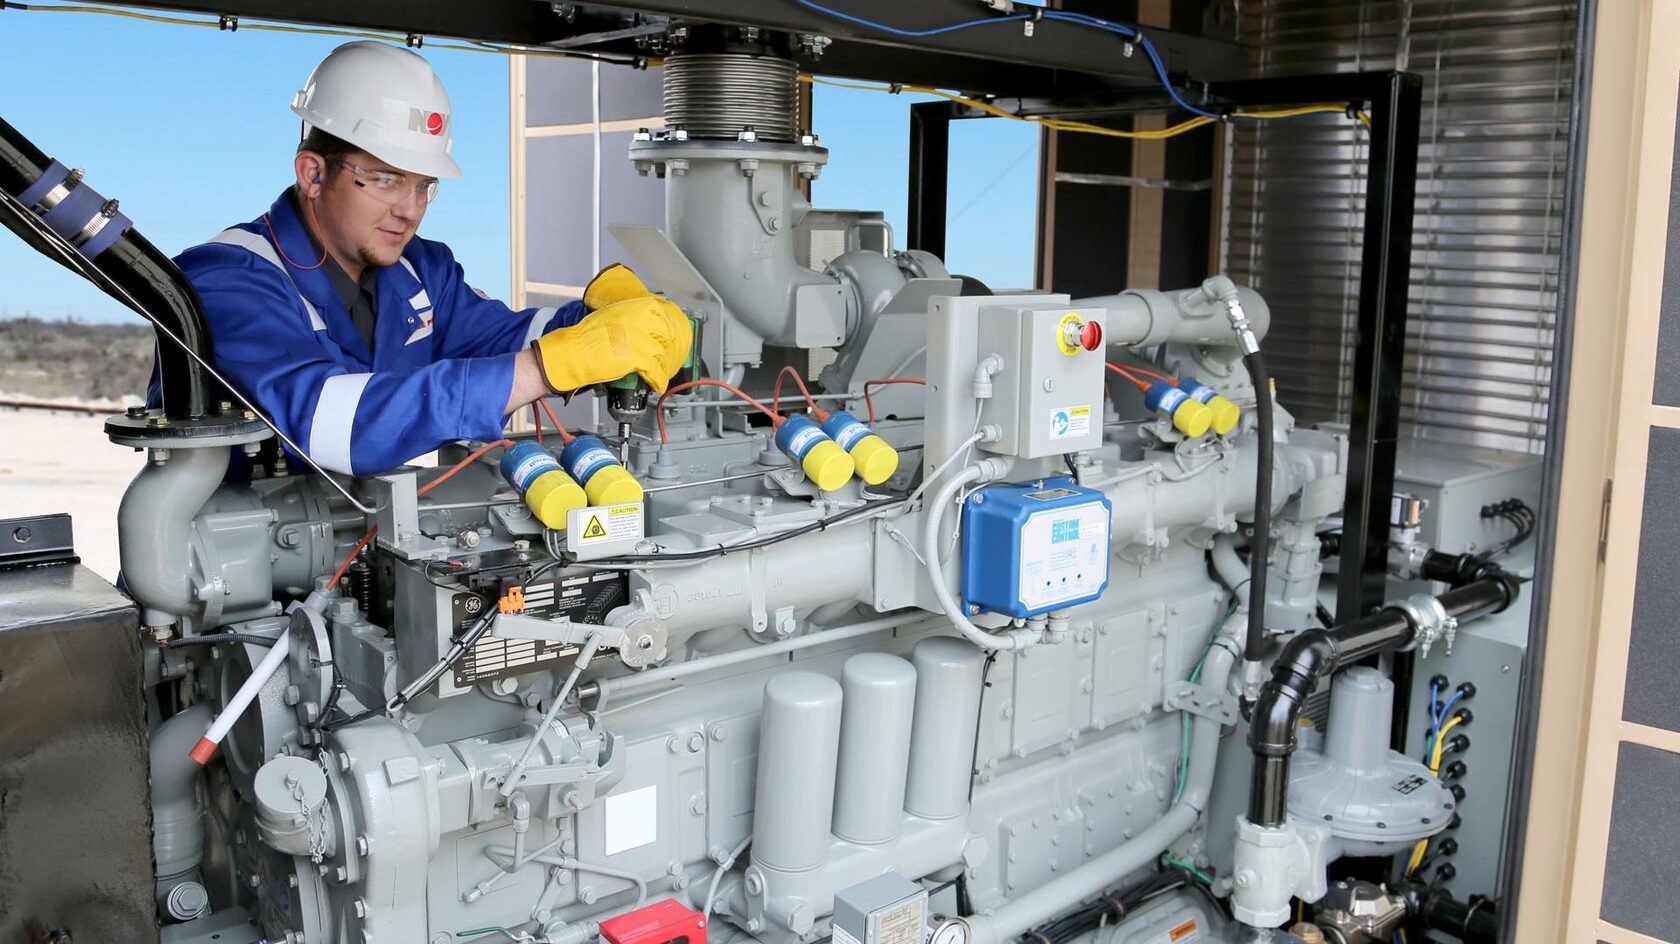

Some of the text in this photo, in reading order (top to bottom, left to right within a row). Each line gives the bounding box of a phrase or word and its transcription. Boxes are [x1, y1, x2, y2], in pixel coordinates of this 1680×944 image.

[408, 107, 450, 136] NOV
[1052, 519, 1080, 532] CUSTOM
[1052, 531, 1080, 545] CONTROL
